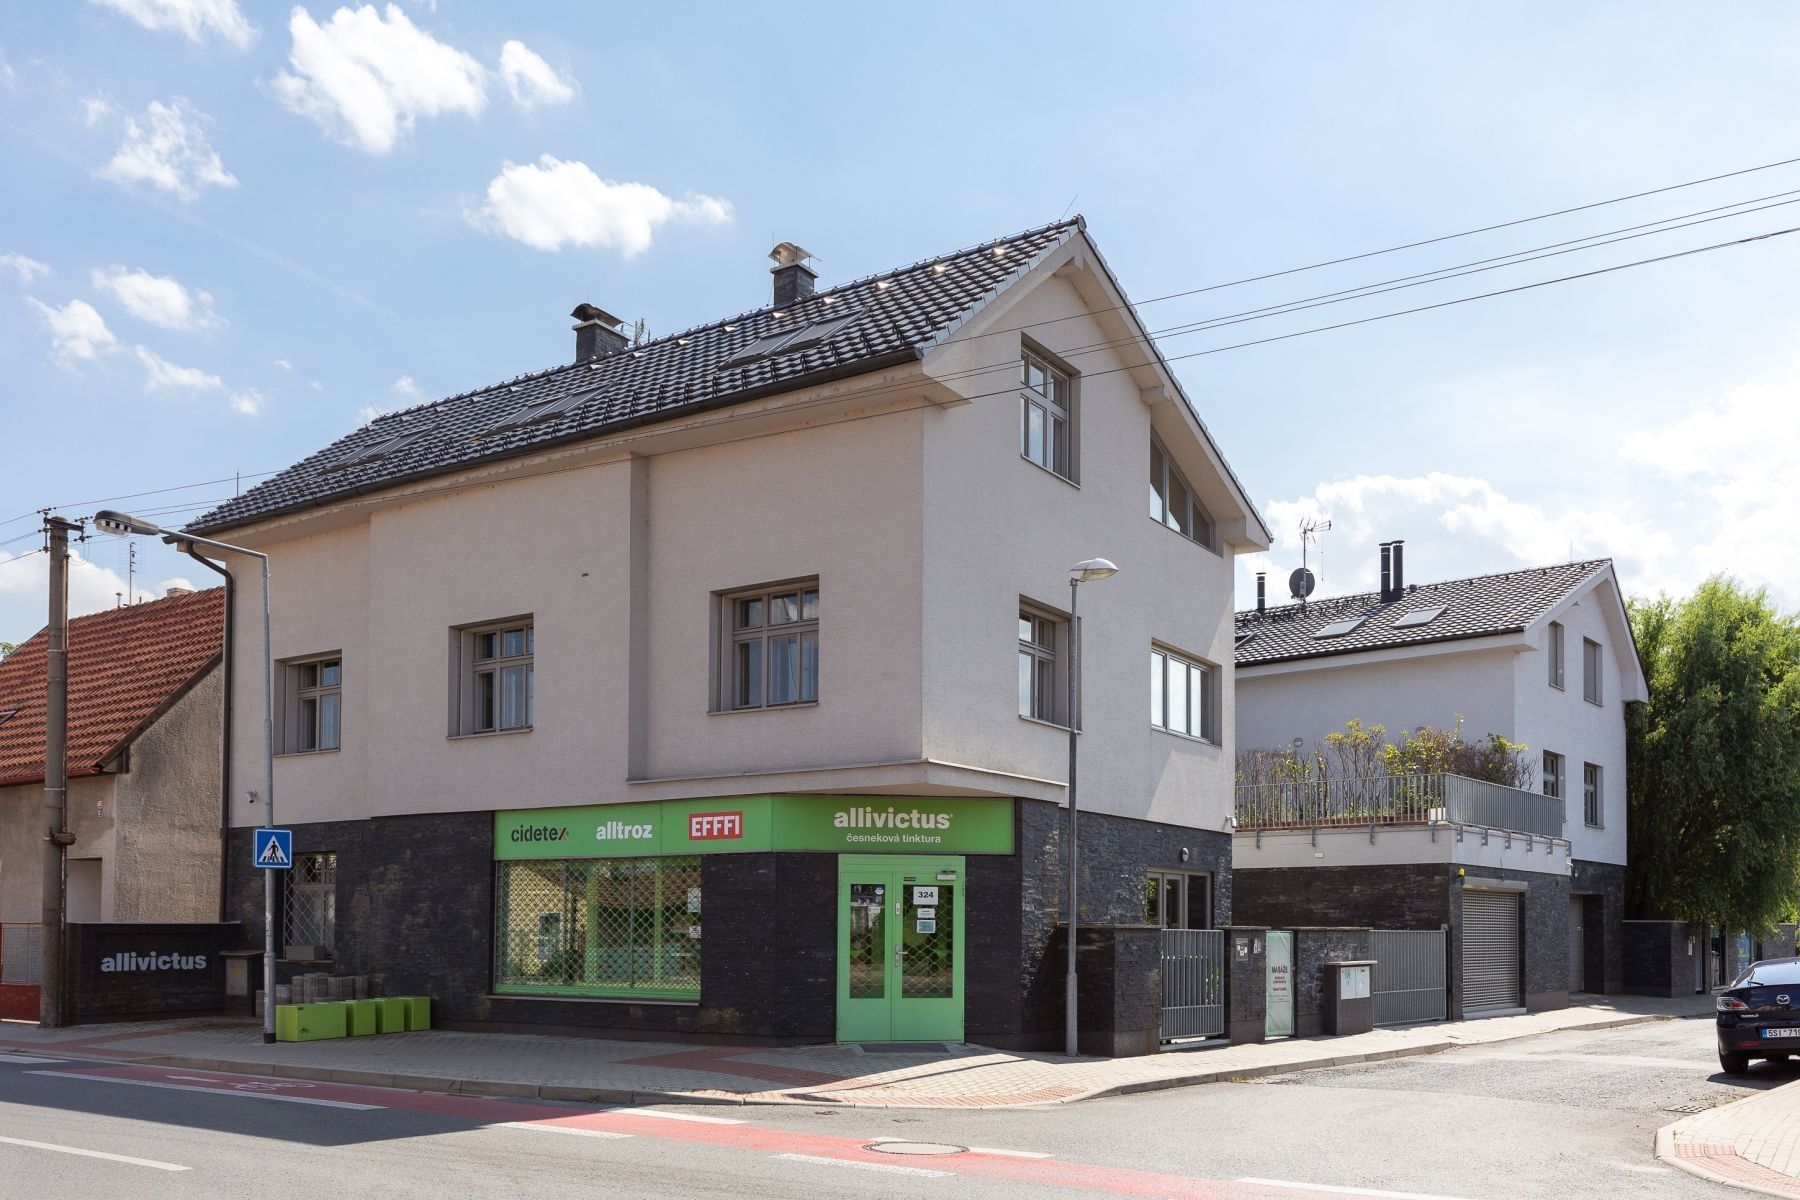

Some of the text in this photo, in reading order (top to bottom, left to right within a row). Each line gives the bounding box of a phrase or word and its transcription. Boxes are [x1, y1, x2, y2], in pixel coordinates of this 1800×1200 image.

[691, 815, 740, 837] EFFFI
[833, 806, 950, 830] allivictus
[511, 824, 568, 843] cidetex
[595, 821, 653, 840] alltroz
[846, 832, 941, 843] česneková tinktura
[917, 891, 934, 899] 324
[100, 951, 207, 973] allivictus
